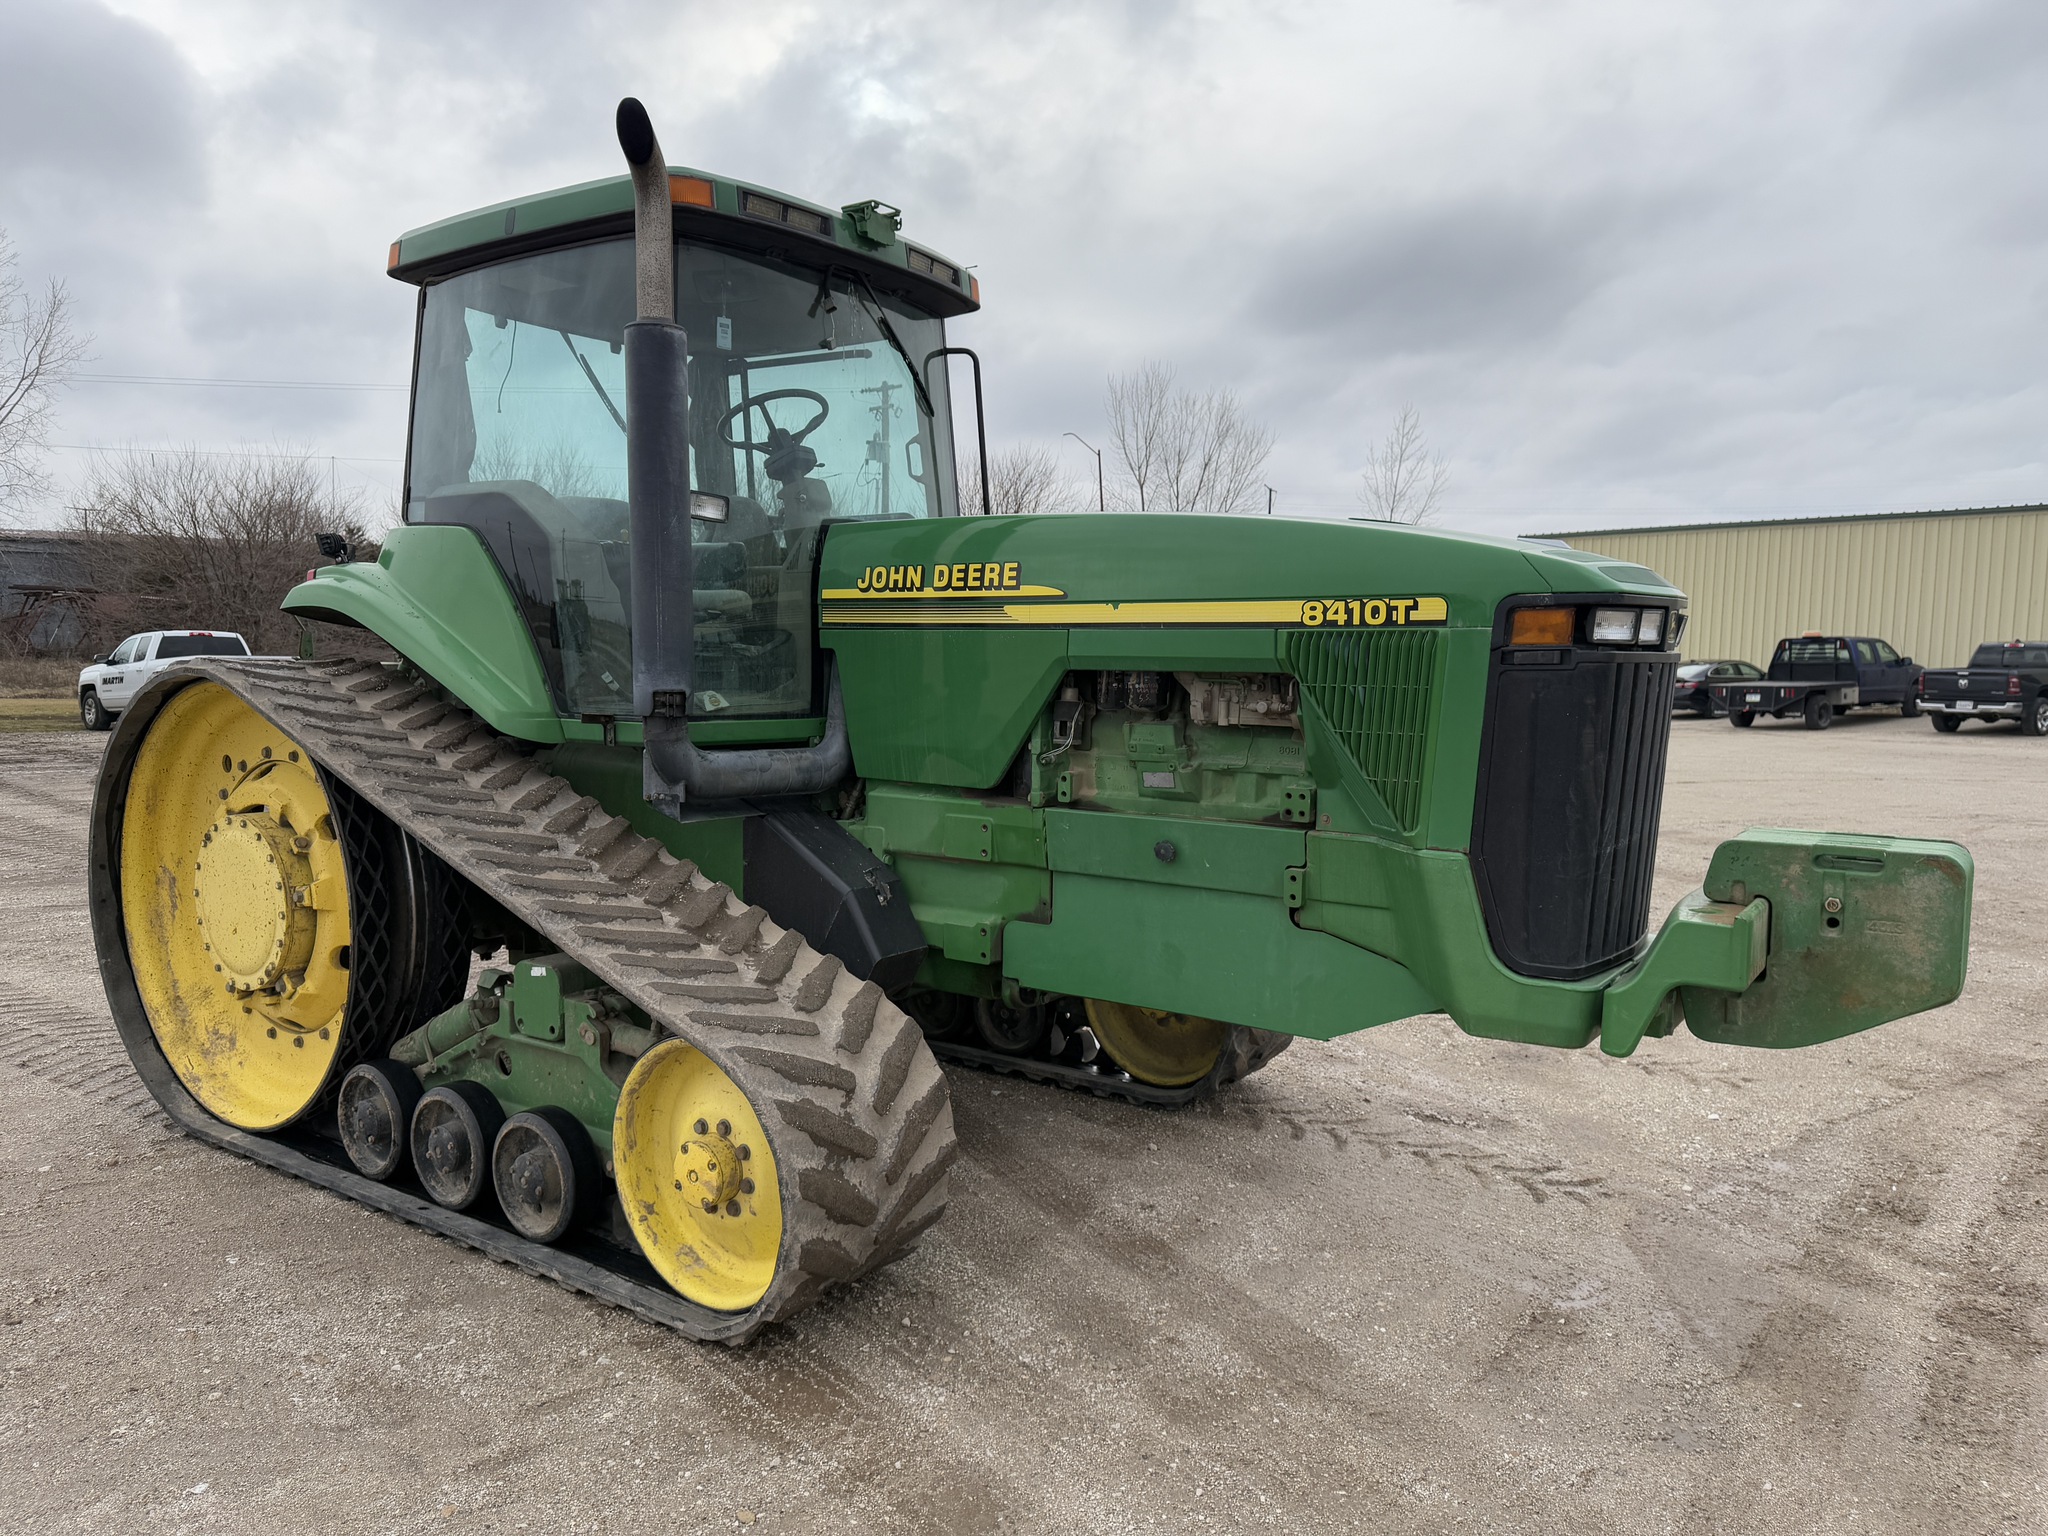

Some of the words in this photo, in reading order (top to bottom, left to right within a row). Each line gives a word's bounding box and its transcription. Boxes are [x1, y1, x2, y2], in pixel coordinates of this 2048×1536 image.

[856, 565, 923, 592] JOHN
[933, 562, 1019, 590] DEERE
[1301, 598, 1415, 626] 8410T
[102, 676, 124, 685] MARTIN
